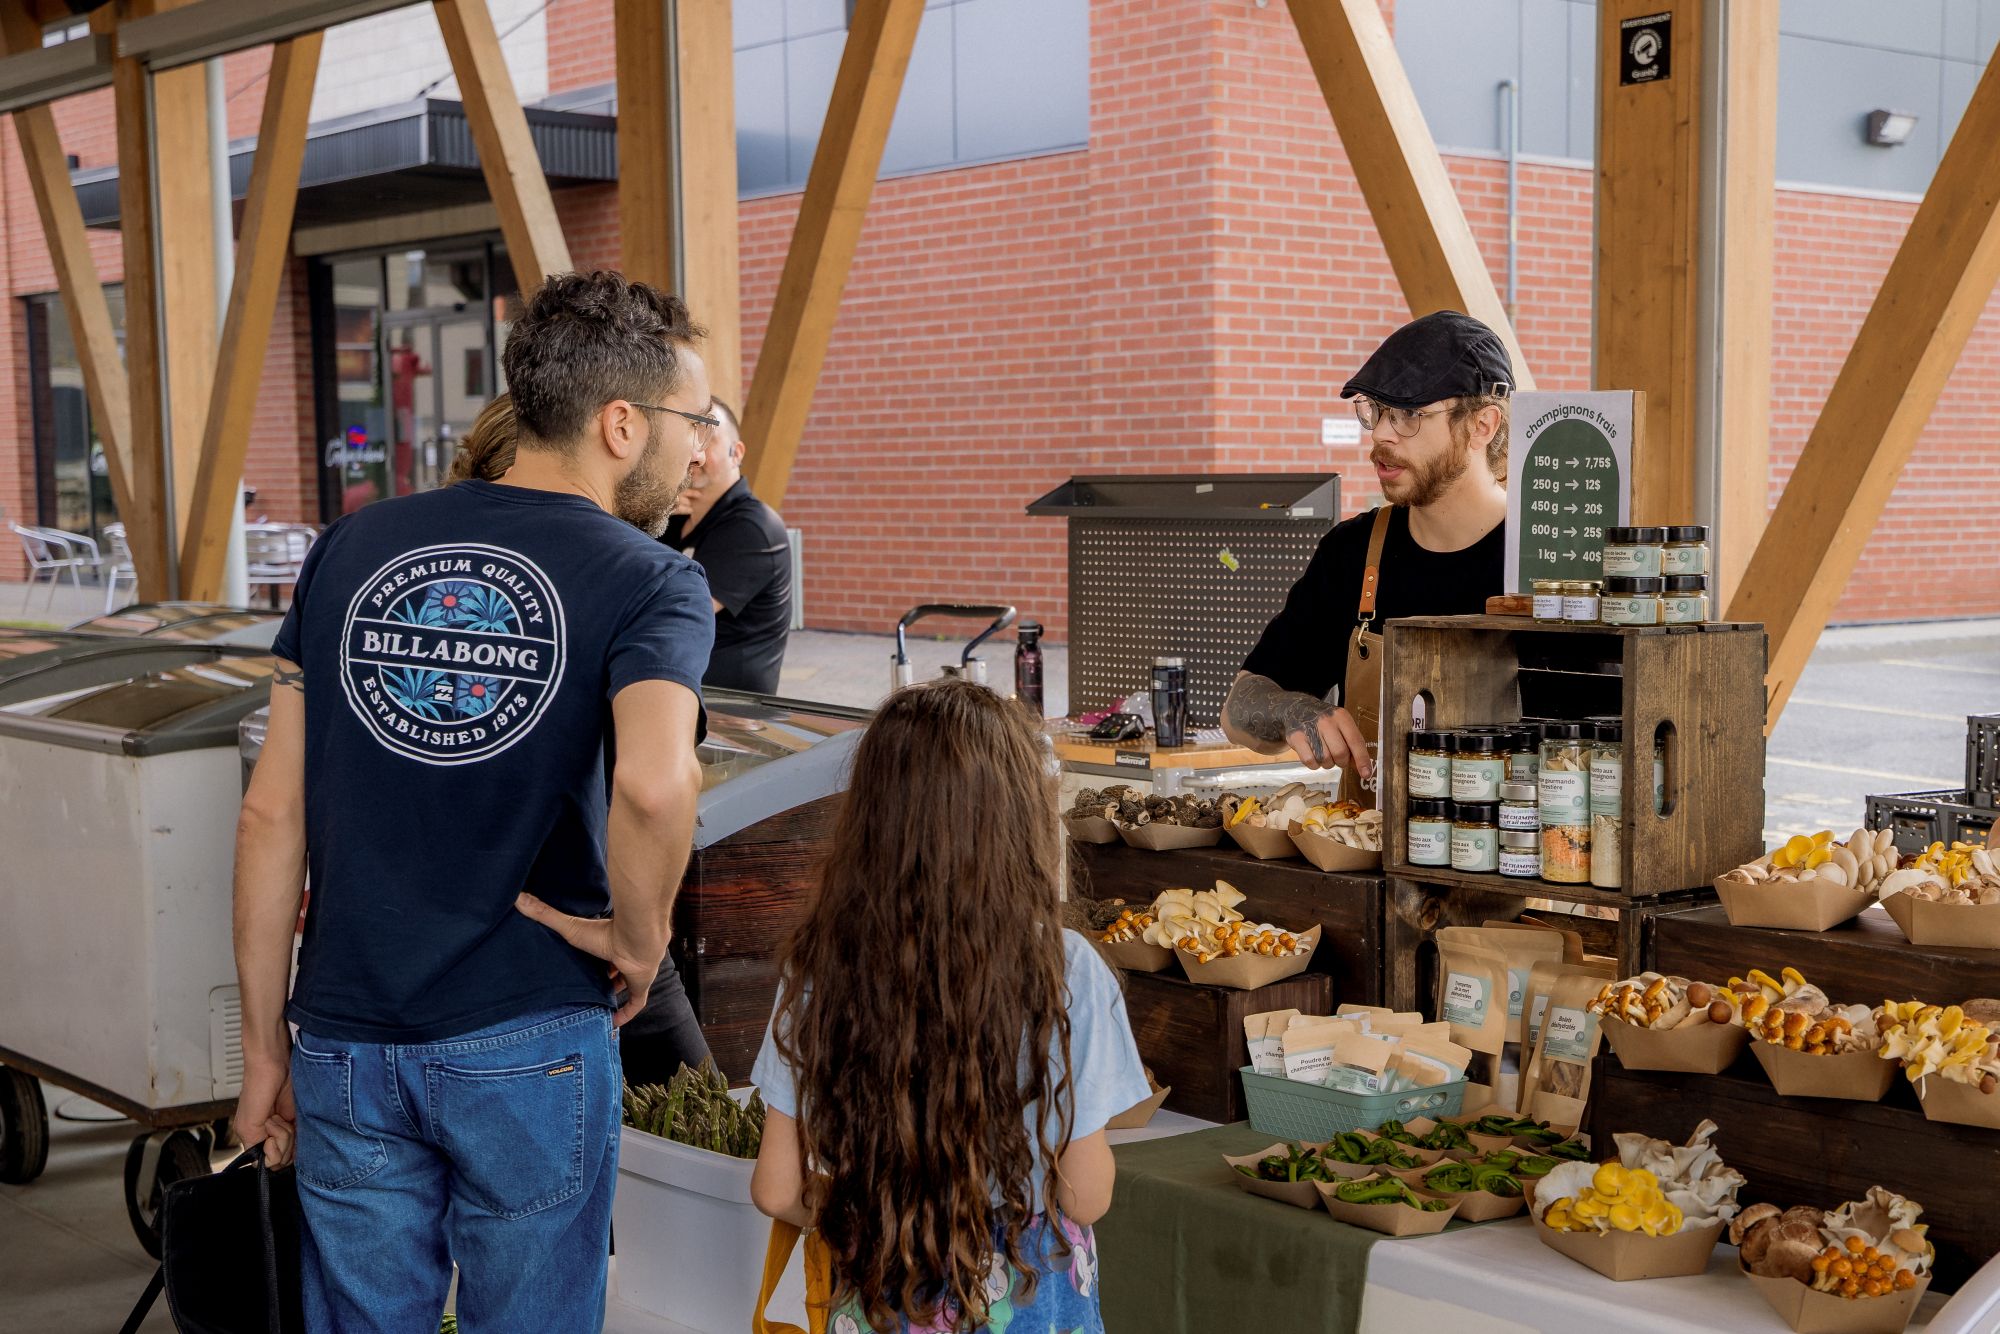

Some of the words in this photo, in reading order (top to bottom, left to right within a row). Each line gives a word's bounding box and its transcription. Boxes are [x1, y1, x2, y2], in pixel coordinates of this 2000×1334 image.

[1525, 404, 1595, 439] champignons
[1596, 412, 1617, 439] frais
[1534, 455, 1550, 467] 150
[1552, 458, 1559, 470] g
[1585, 457, 1611, 469] 7,75$
[1533, 479, 1551, 490] 250
[1552, 481, 1560, 493] g
[1585, 479, 1601, 491] 12$
[1531, 501, 1550, 512] 450
[1551, 503, 1559, 515] g
[1584, 503, 1603, 515] 20$
[1531, 524, 1550, 535] 600
[1551, 526, 1559, 538] g
[1583, 527, 1602, 538] 25$
[1583, 551, 1601, 562] 40$
[372, 559, 472, 608] PREMIUM
[482, 563, 543, 624] QUALITY
[362, 630, 539, 671] BILLABONG
[362, 676, 487, 746] ESTABLISHED
[492, 692, 529, 732] 1973
[1265, 1051, 1284, 1059] champi
[1300, 1057, 1321, 1065] Poudre
[548, 1065, 574, 1076] VOLCOM
